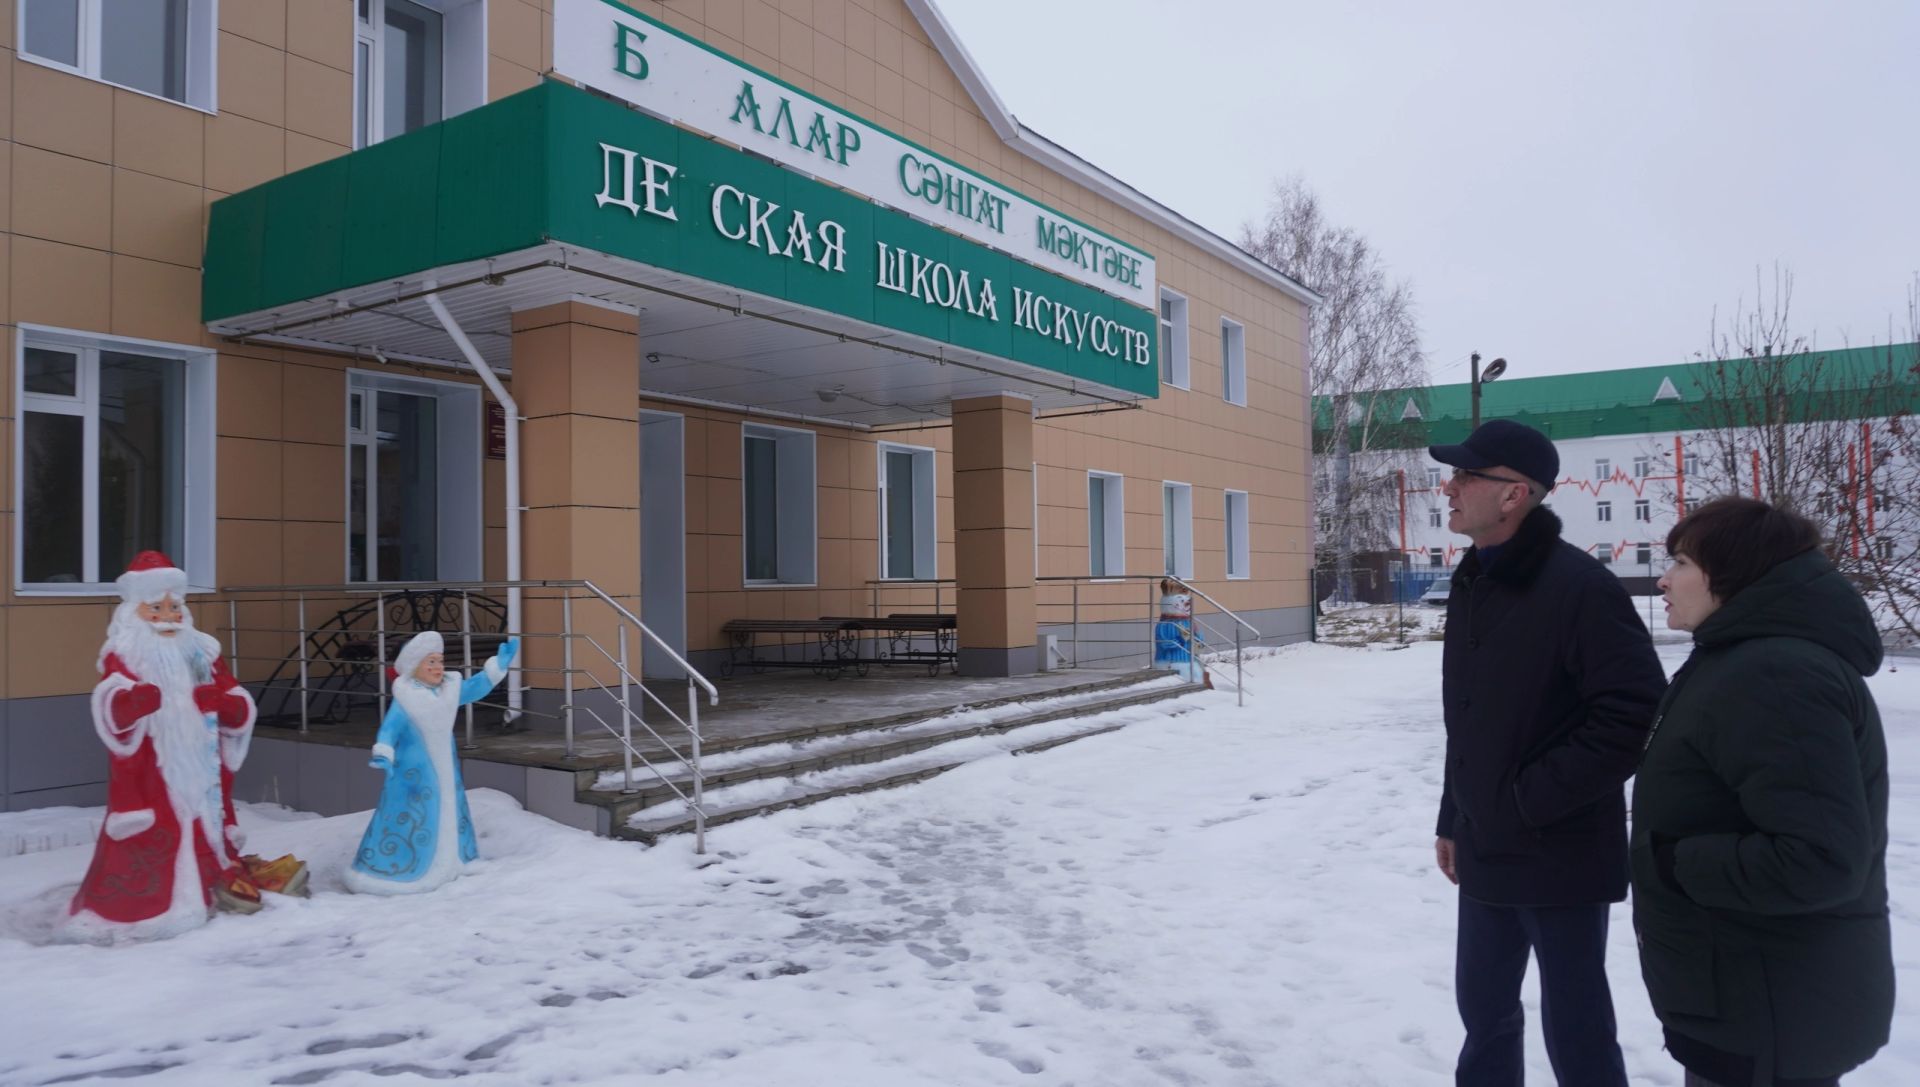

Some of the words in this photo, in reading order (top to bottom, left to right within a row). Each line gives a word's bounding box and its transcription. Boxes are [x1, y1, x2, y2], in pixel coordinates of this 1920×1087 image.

[901, 153, 1009, 234] СӘНГАТ
[1037, 215, 1142, 290] МӘКТӘБЕ
[876, 242, 999, 321] ШКОЛА
[1013, 287, 1150, 366] ИСКУССТВ
